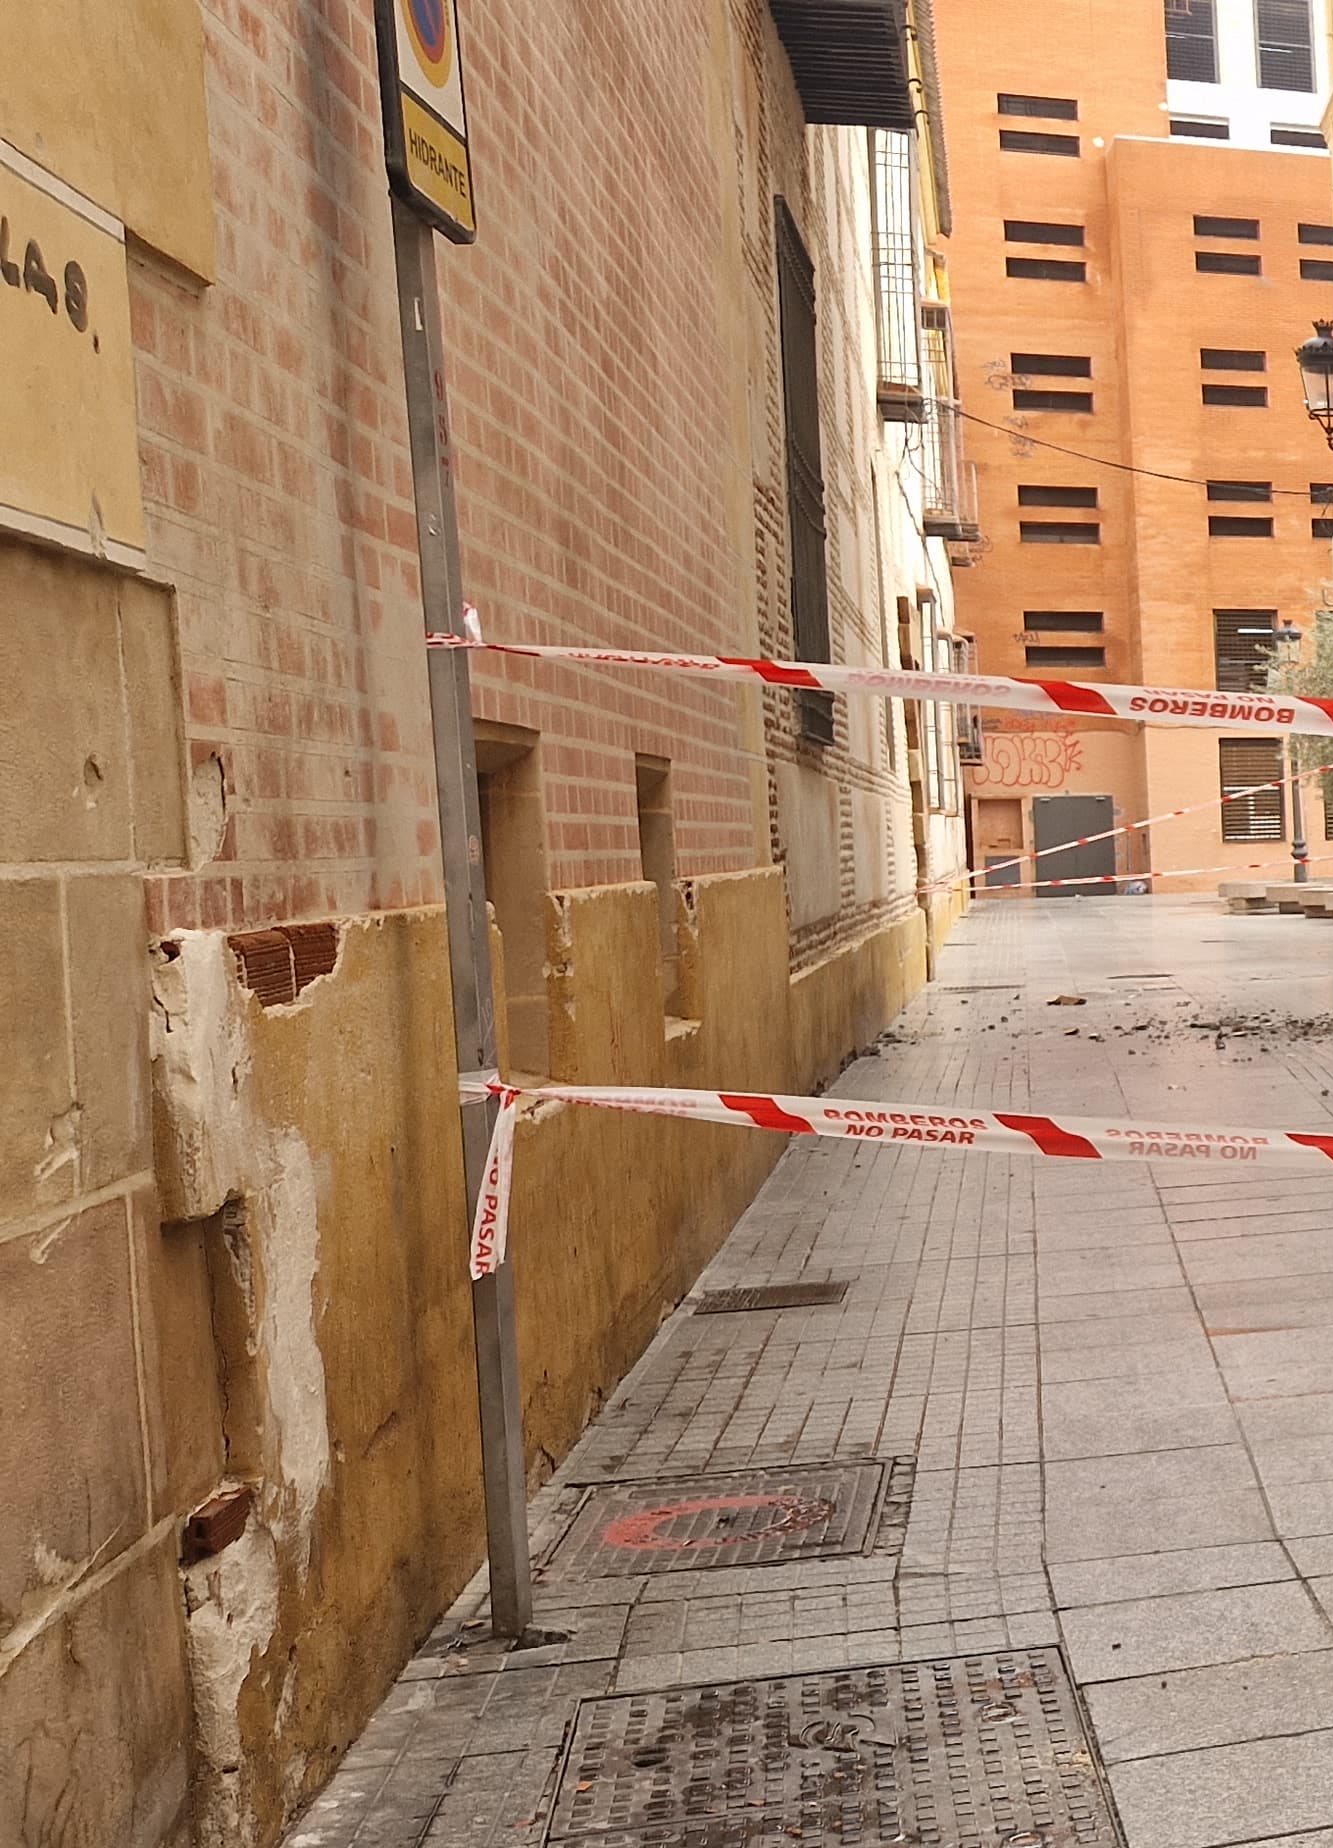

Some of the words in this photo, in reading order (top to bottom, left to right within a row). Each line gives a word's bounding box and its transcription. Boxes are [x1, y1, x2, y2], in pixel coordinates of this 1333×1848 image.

[409, 128, 466, 199] HIDRANTE
[1129, 696, 1295, 724] BOMBEROS
[824, 1108, 988, 1131] BOMBEROS
[845, 1124, 884, 1137] NO
[890, 1127, 976, 1145] PASAR
[474, 1194, 499, 1275] PASAR
